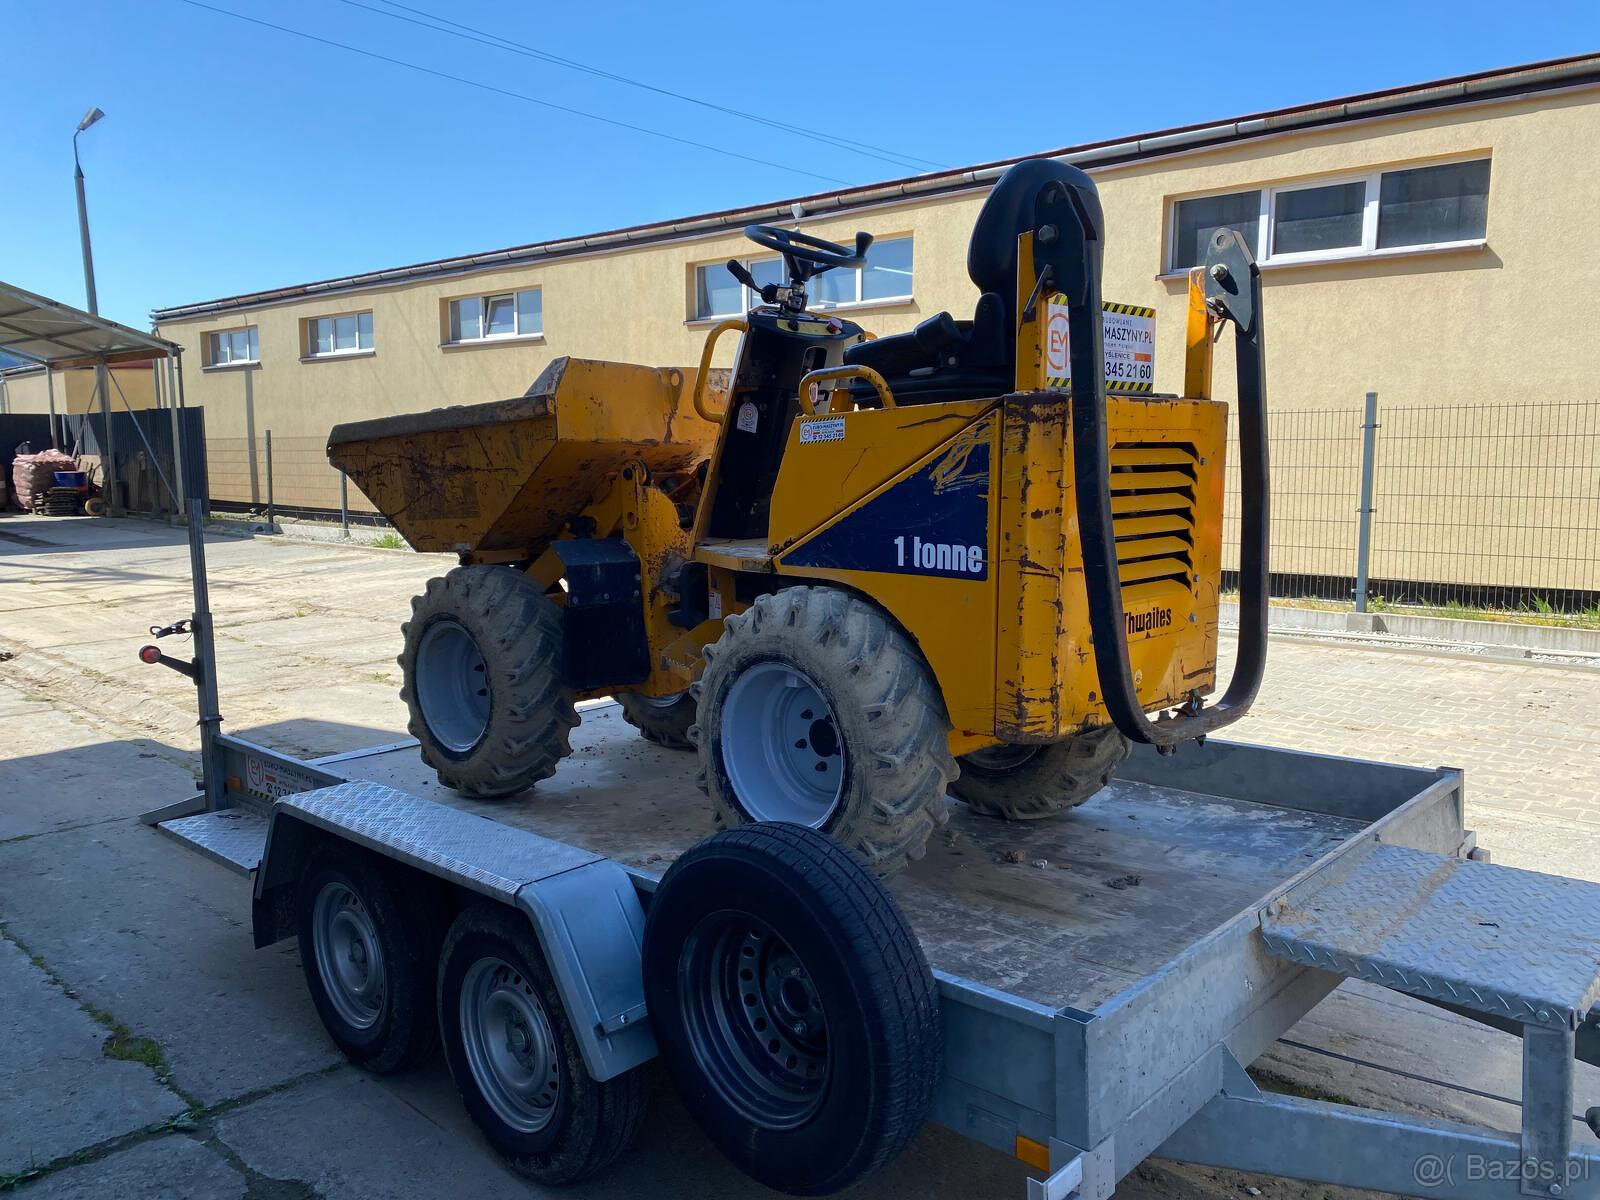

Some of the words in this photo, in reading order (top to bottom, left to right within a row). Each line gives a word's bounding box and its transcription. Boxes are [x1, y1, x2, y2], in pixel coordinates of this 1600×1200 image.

[1104, 326, 1153, 344] MASZYNY.PL
[1105, 351, 1131, 360] YŚLENICE
[1105, 361, 1124, 378] 345
[1126, 363, 1138, 379] 21
[1139, 364, 1152, 379] 60
[894, 536, 904, 566] 1
[913, 536, 983, 573] tonne
[1123, 606, 1172, 635] Thwaites
